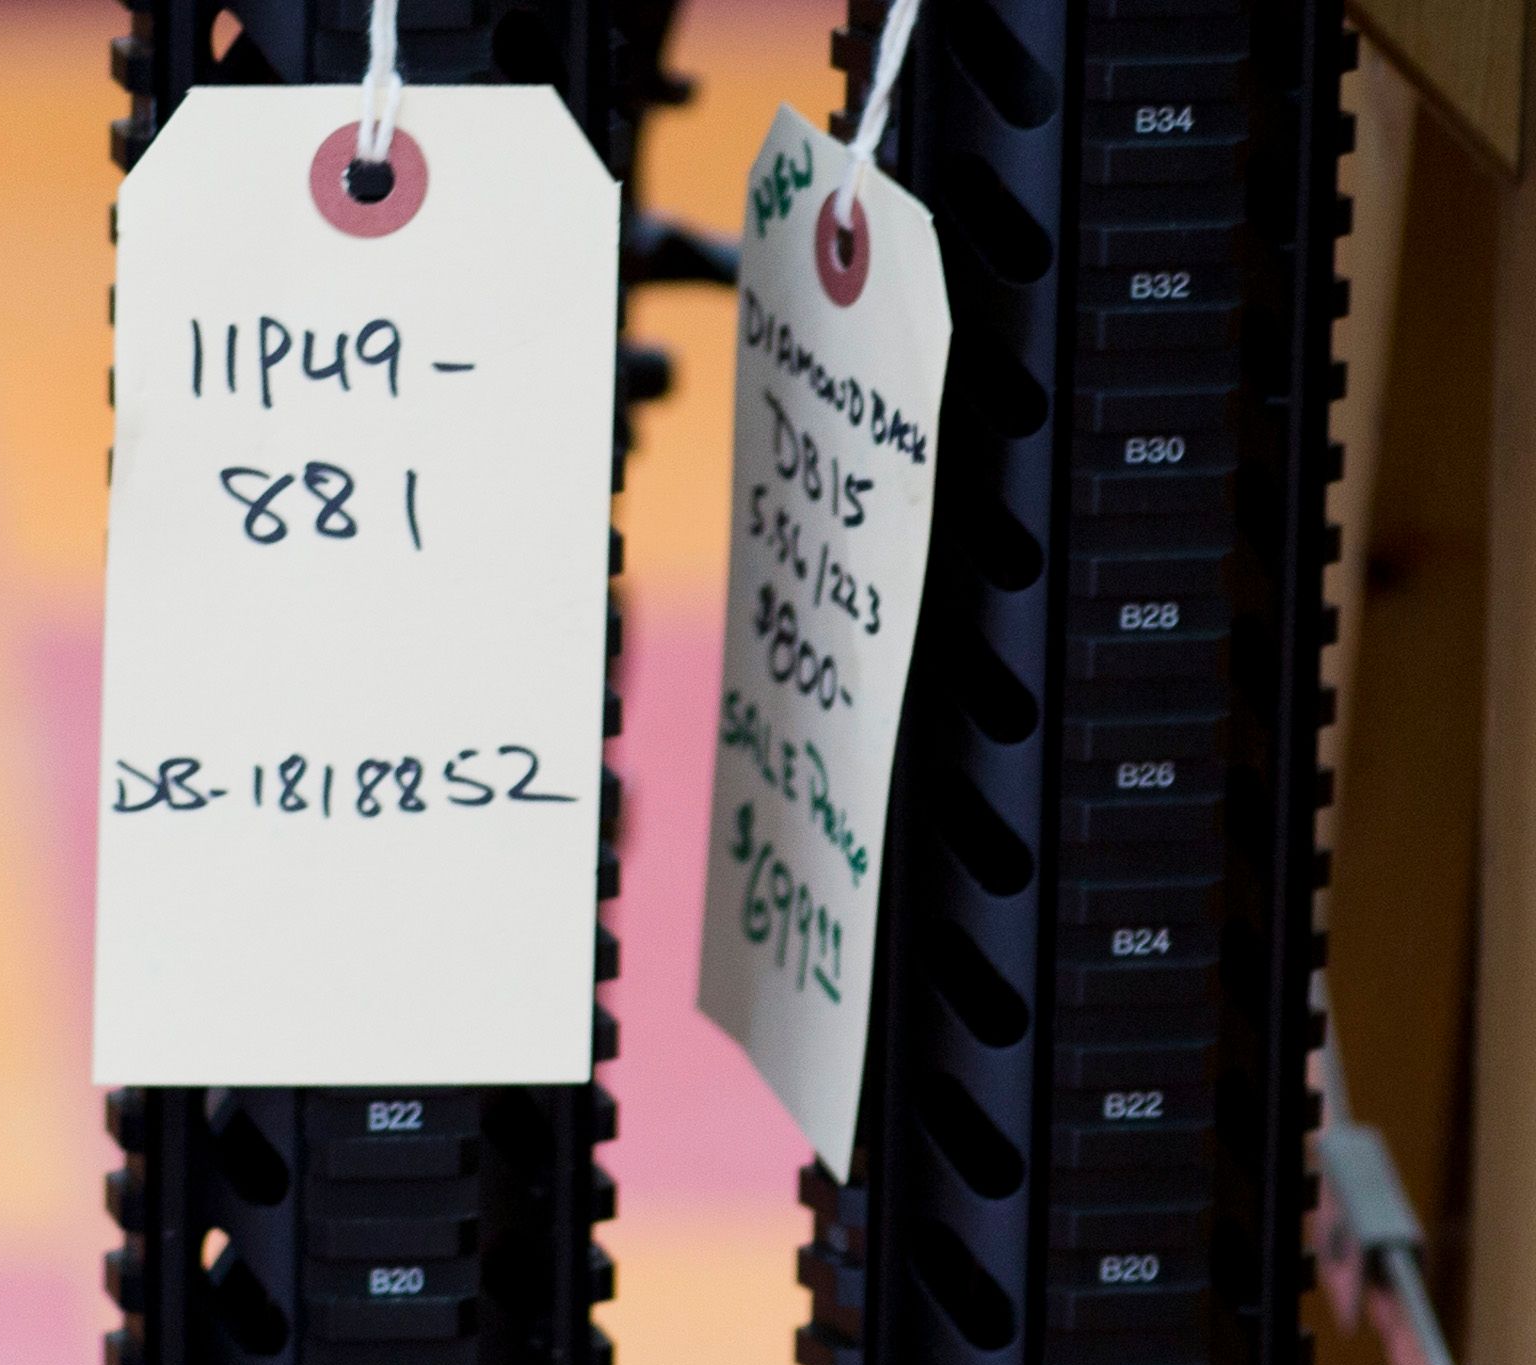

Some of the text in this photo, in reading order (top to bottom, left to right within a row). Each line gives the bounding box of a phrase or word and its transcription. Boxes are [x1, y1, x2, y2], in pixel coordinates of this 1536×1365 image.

[1134, 105, 1195, 135] B34
[752, 137, 814, 241] NEW
[1129, 271, 1191, 301] B32
[766, 388, 873, 528] DB15
[1123, 436, 1186, 465] B30
[220, 461, 423, 550] 881
[1118, 602, 1180, 631] B28
[721, 688, 797, 802] SALE
[112, 744, 581, 819] DB-1818852
[1116, 762, 1176, 790] B26
[1111, 927, 1171, 957] B24
[367, 1100, 423, 1132] B22
[1102, 1091, 1164, 1120] B22
[368, 1266, 425, 1296] B20
[1099, 1254, 1160, 1284] B20
